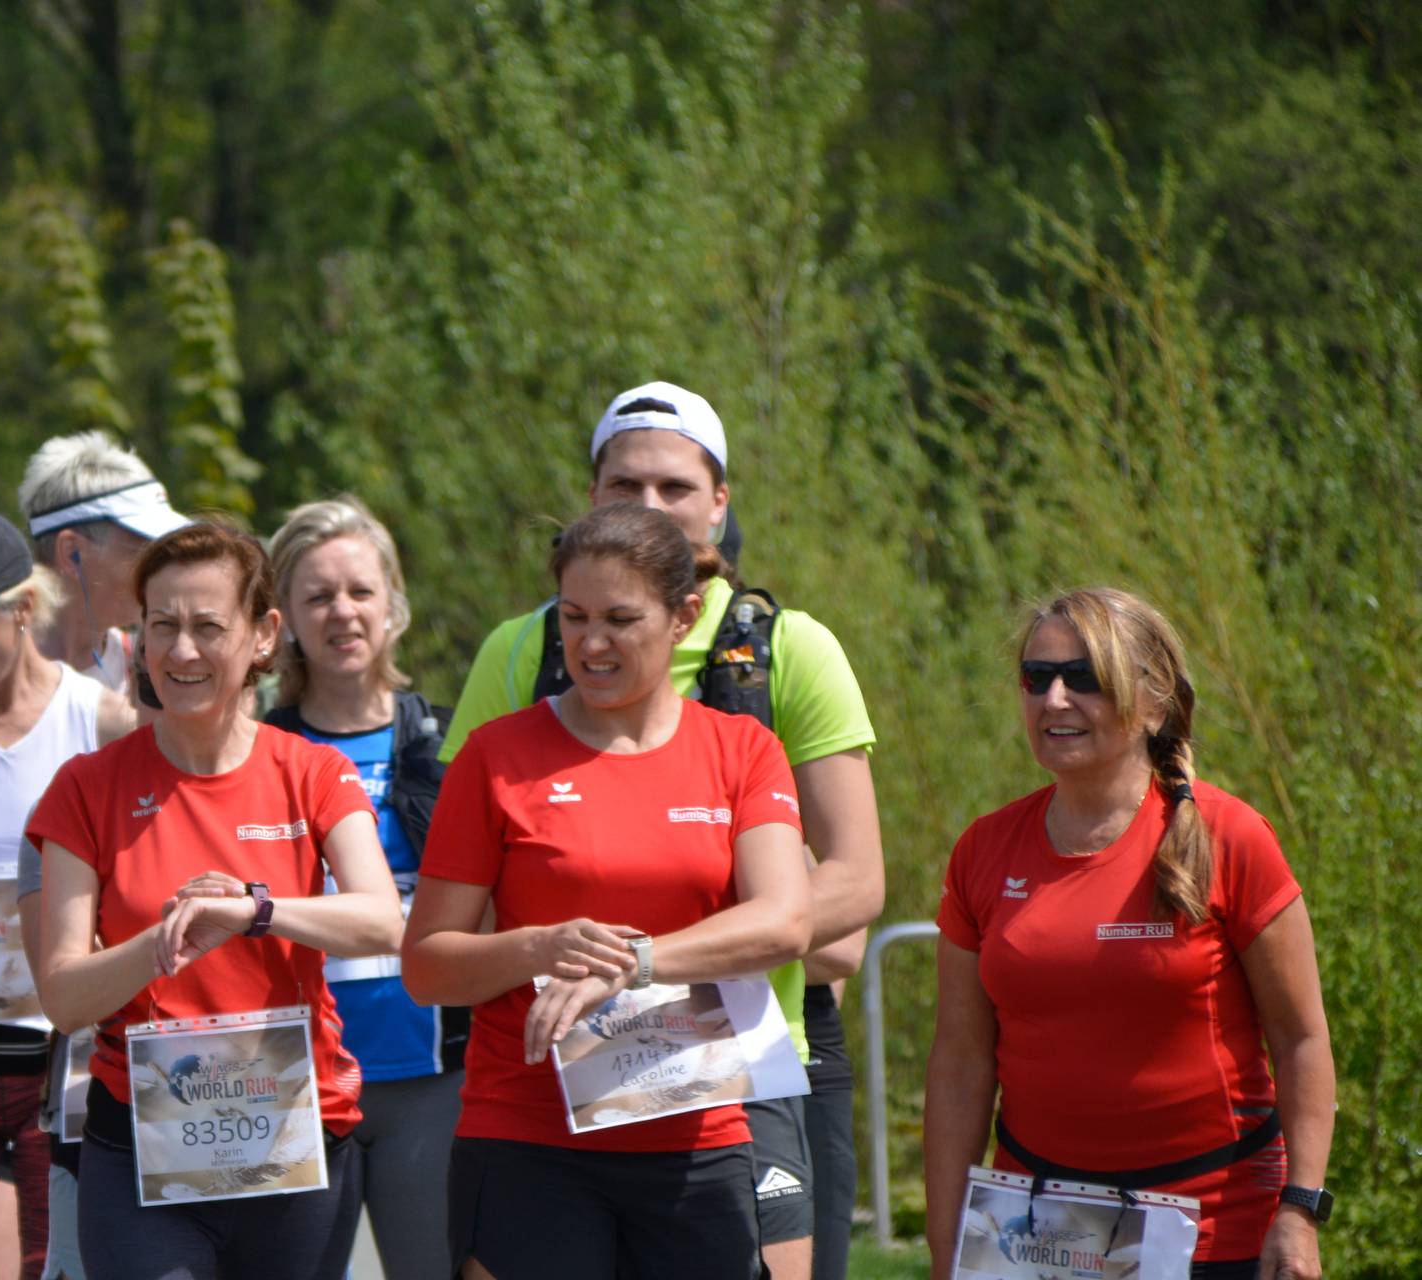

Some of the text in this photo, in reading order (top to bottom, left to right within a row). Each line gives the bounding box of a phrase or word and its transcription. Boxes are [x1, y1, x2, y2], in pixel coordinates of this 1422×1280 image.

[238, 827, 283, 838] Number
[1097, 924, 1175, 937] Number RUN
[606, 1014, 664, 1037] WORLD
[186, 1075, 278, 1102] WORLD RUN
[182, 1115, 270, 1147] 83509
[213, 1147, 244, 1159] Karin
[1015, 1243, 1105, 1272] WORLD RUN
